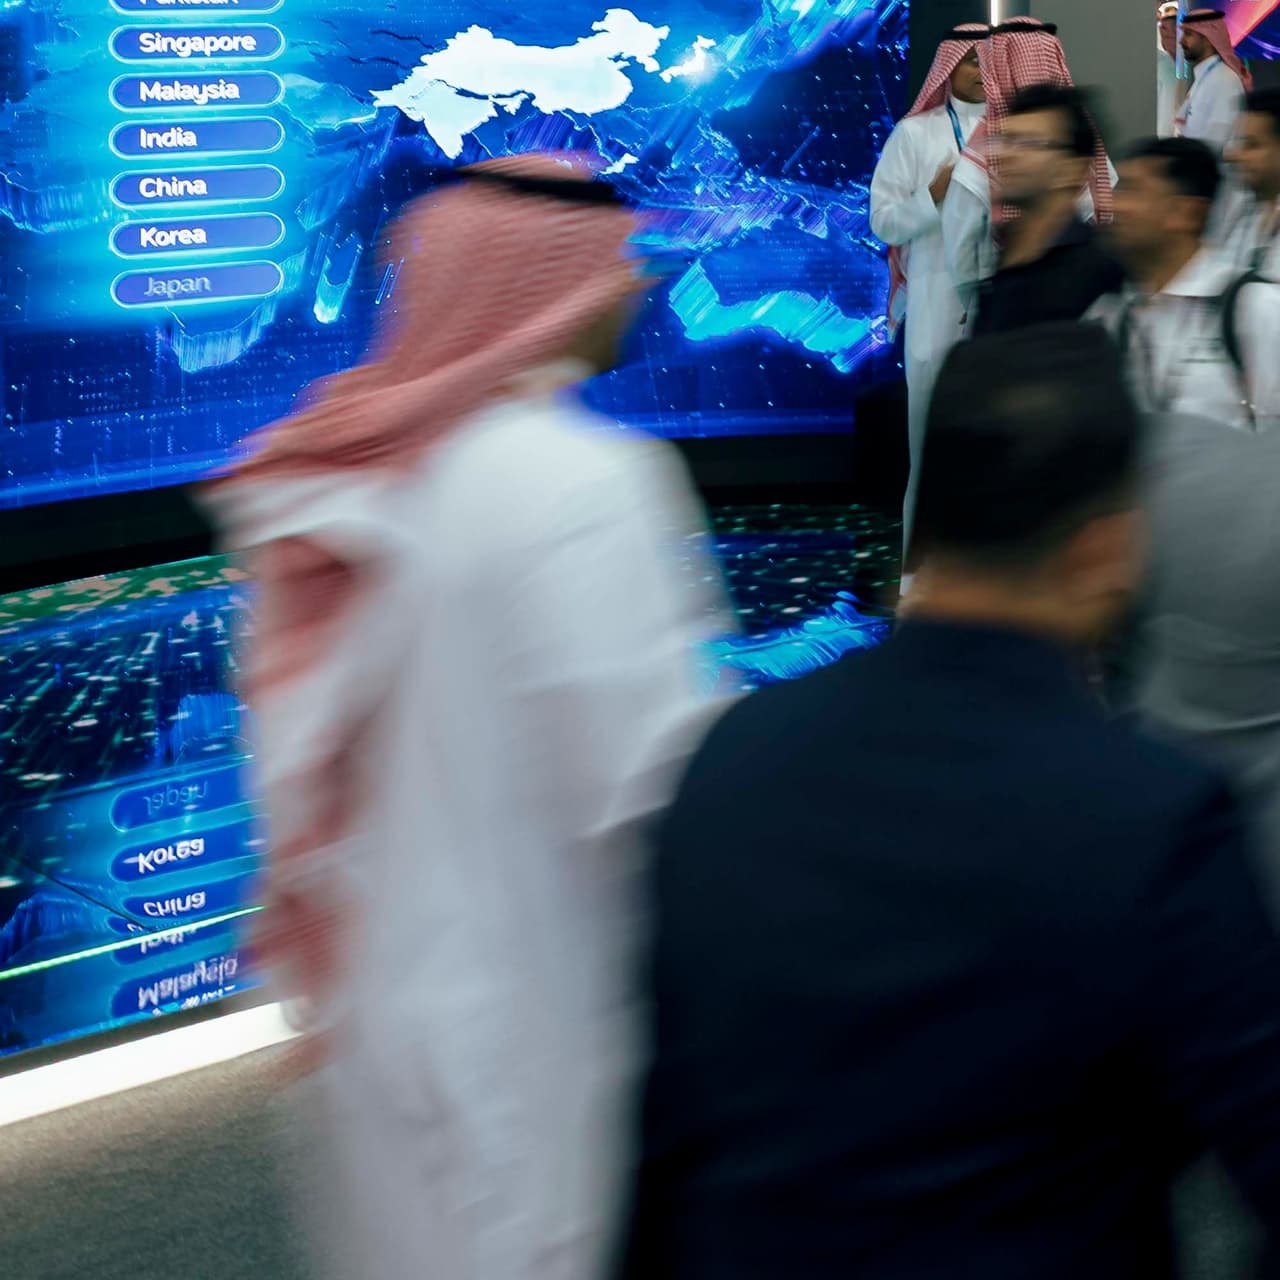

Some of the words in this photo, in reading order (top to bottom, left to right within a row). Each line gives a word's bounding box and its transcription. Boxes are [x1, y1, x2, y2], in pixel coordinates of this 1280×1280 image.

[139, 32, 257, 58] Singapore
[139, 79, 241, 105] Malaysia
[140, 127, 198, 148] India
[139, 176, 208, 198] China
[140, 227, 207, 248] Korea
[144, 275, 212, 298] Japan
